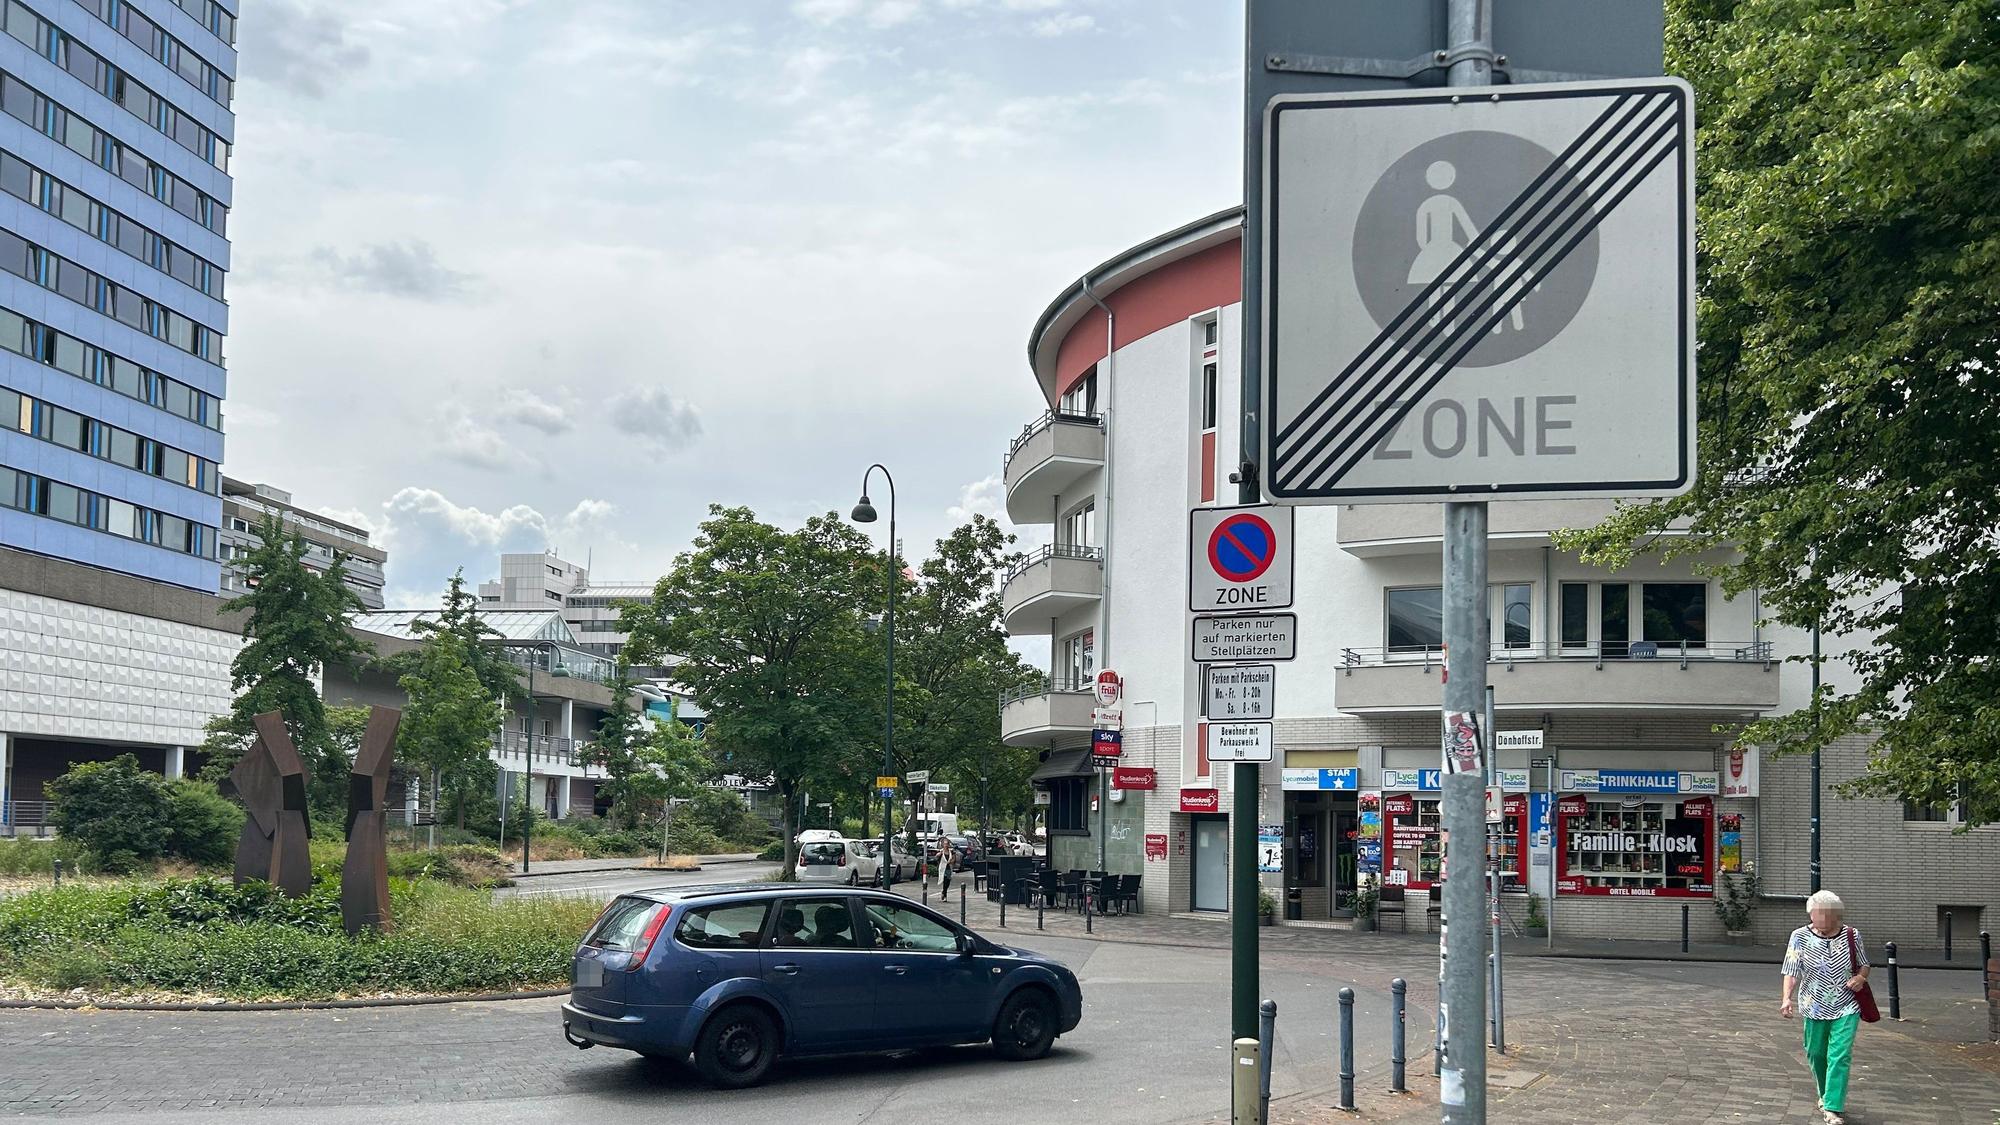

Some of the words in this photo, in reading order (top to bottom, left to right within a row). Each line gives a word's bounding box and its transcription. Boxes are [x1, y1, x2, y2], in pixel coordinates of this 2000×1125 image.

[1373, 395, 1576, 460] ZONE
[1216, 586, 1268, 605] ZONE
[1212, 619, 1251, 630] Parken
[1256, 620, 1275, 629] nur
[1202, 633, 1220, 643] auf
[1224, 631, 1286, 642] markierten
[1211, 645, 1276, 657] Stellplätzen
[1212, 672, 1229, 684] Parken
[1230, 672, 1240, 683] mit
[1240, 670, 1270, 683] Parkschein
[1101, 685, 1116, 695] Früh
[1227, 702, 1236, 714] Sa.
[1101, 732, 1114, 742] sky
[1221, 726, 1249, 737] Bewohner
[1250, 726, 1259, 736] mit
[1219, 737, 1254, 747] Parkausweis
[1255, 737, 1260, 746] A
[1497, 735, 1542, 746] Dönhoffstr.
[1235, 748, 1245, 758] frei
[1327, 769, 1351, 777] STAR
[1397, 772, 1418, 781] Lyca
[1504, 773, 1527, 781] Lyca
[1282, 775, 1318, 783] Lycamobile
[1600, 775, 1676, 788] TRINKHALLE
[1693, 775, 1716, 784] Lyca
[1573, 833, 1636, 852] Familie
[1649, 834, 1697, 853] Kiosk
[1631, 888, 1656, 896] MOBILE
